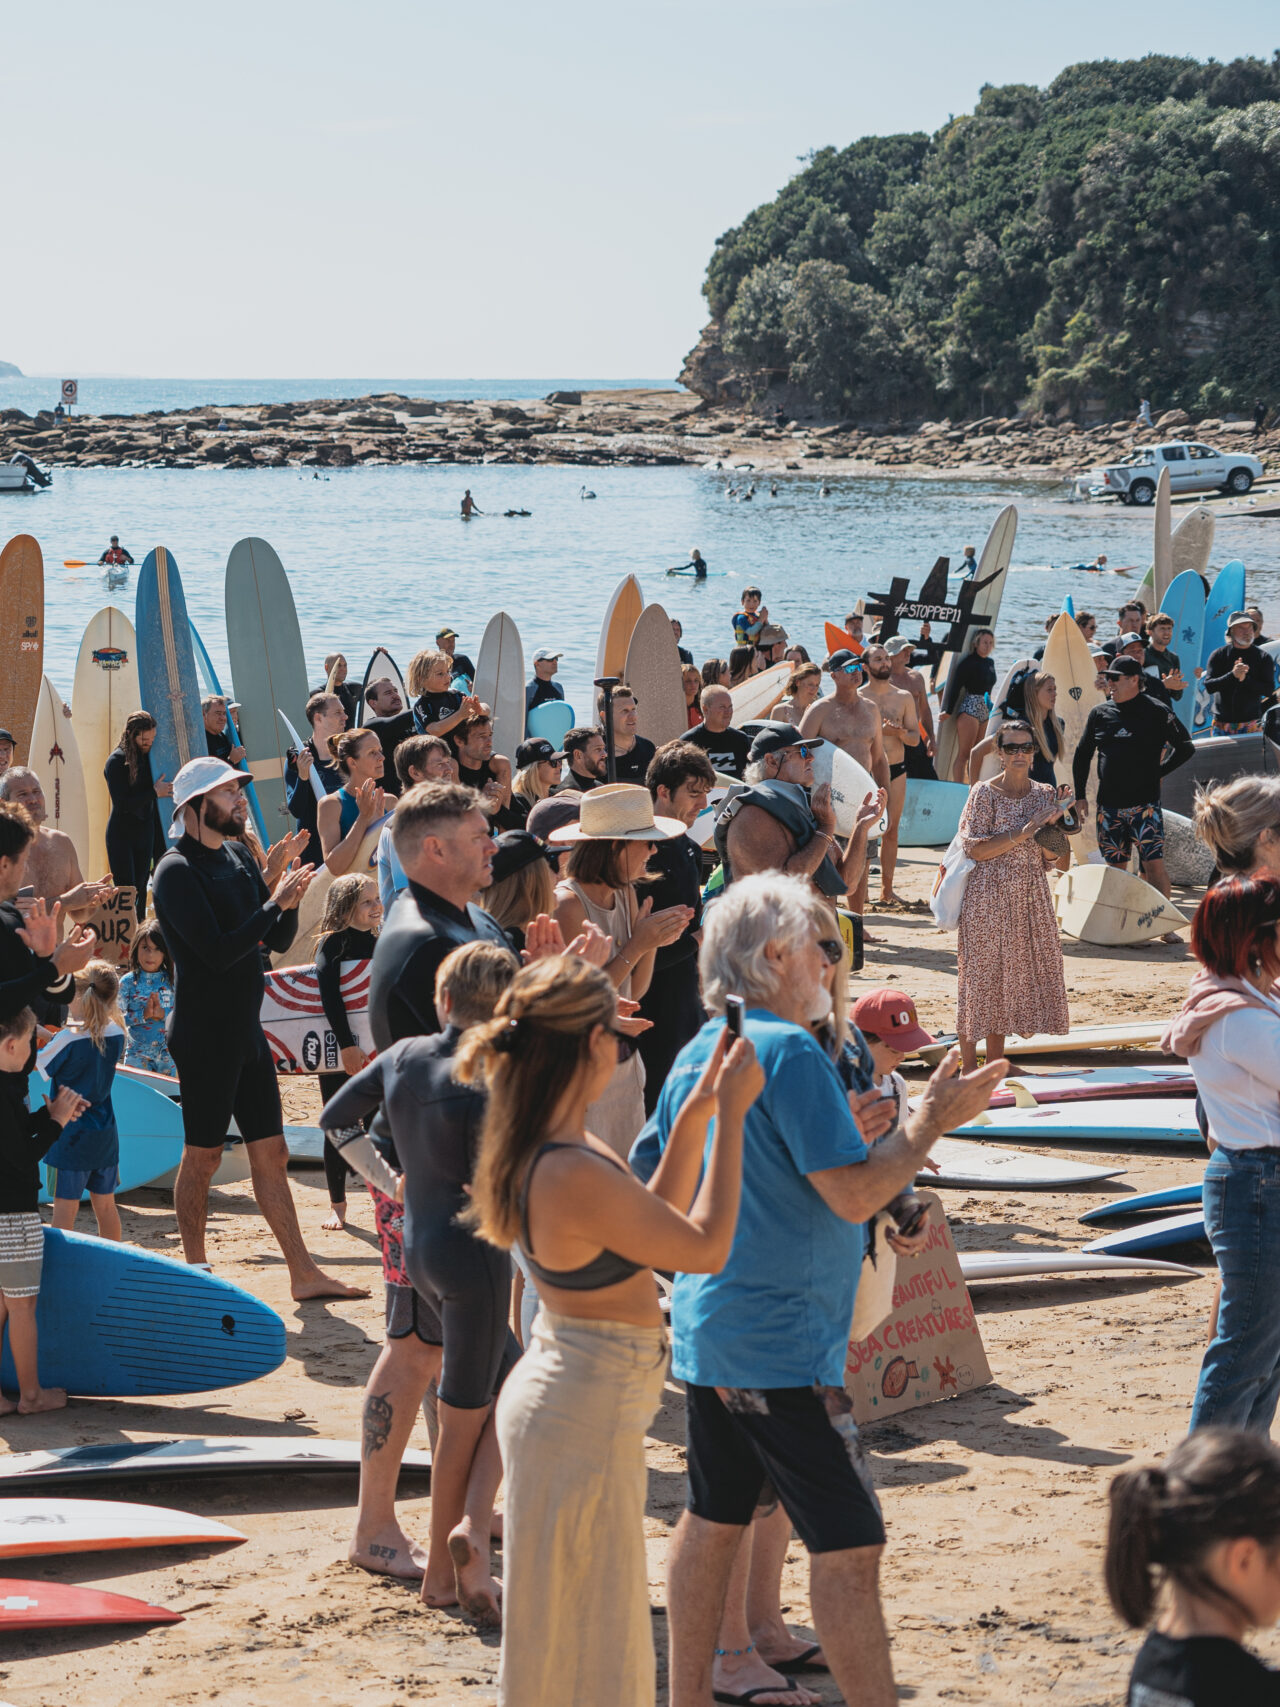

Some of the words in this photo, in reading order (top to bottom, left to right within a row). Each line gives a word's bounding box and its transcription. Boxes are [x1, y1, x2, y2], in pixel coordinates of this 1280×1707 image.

[894, 602, 962, 623] #STOPPEP11
[307, 1037, 318, 1066] four
[326, 1046, 336, 1068] LEUS
[923, 1223, 950, 1253] URT
[892, 1266, 957, 1309] EAUTIFUL
[846, 1333, 884, 1374] SEA
[883, 1290, 977, 1350] CREATURES!
